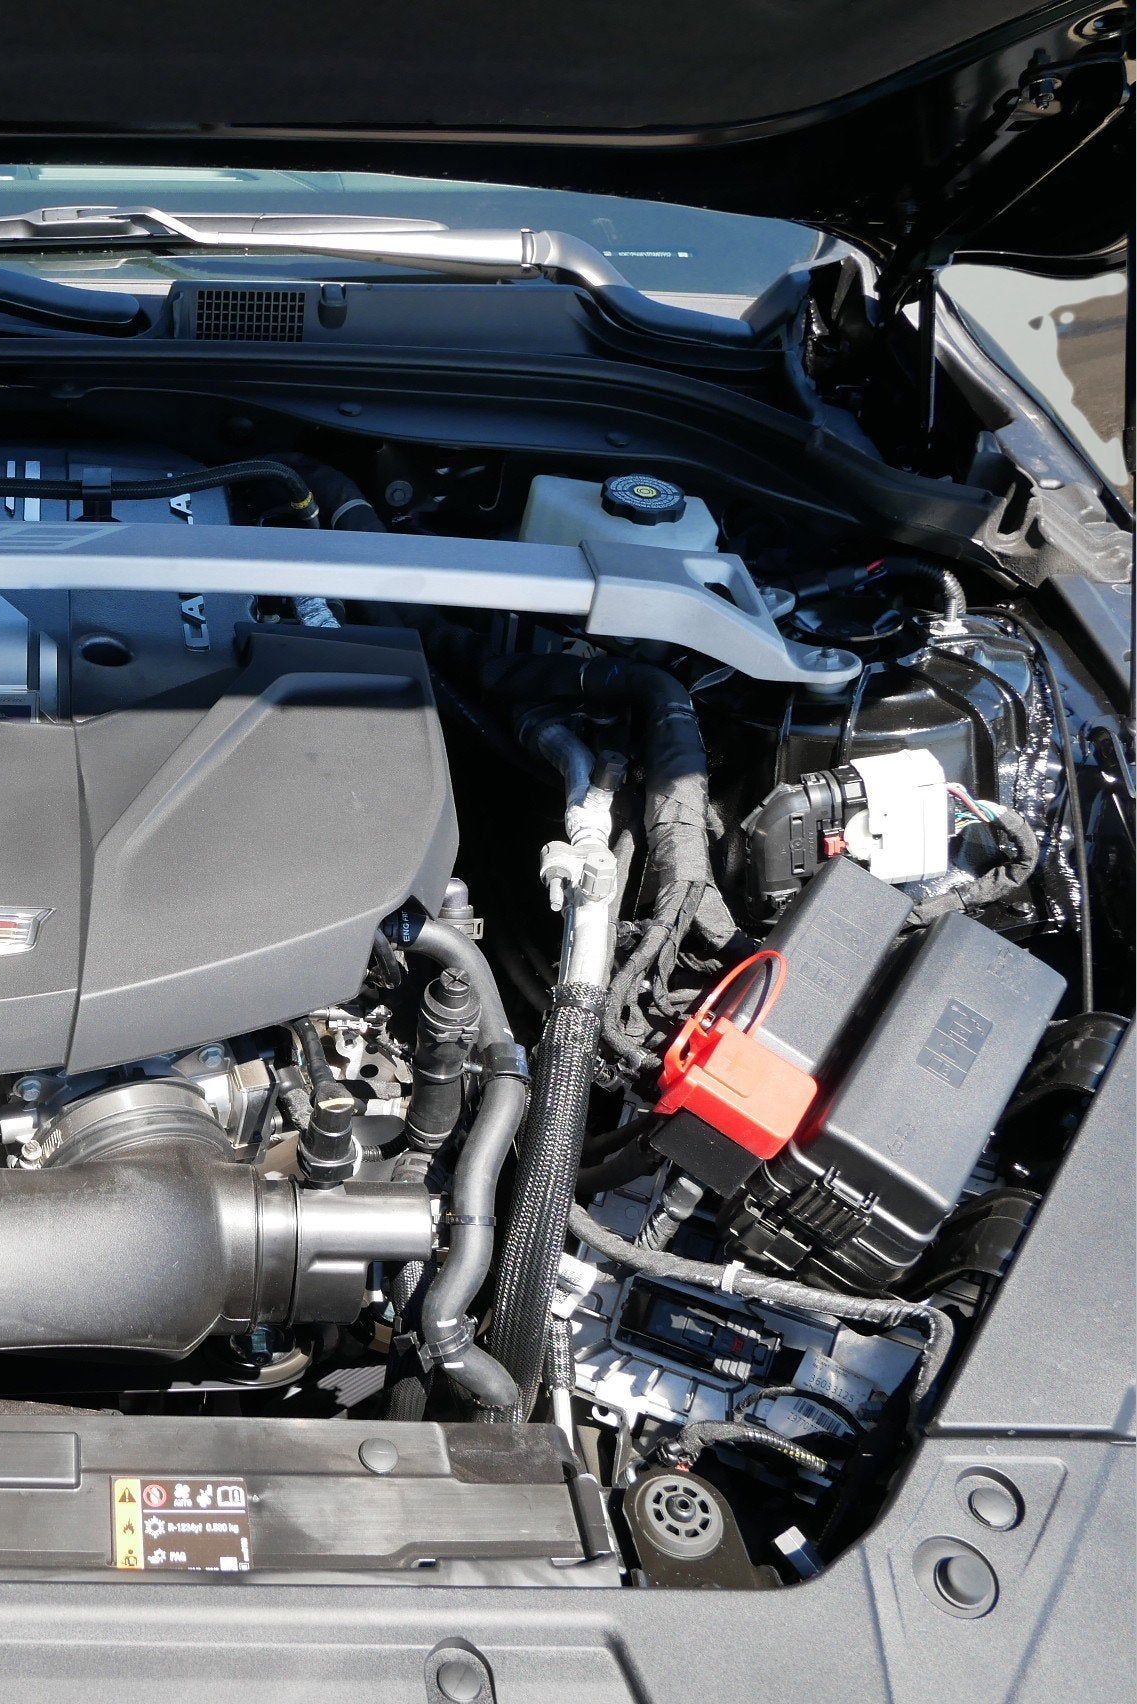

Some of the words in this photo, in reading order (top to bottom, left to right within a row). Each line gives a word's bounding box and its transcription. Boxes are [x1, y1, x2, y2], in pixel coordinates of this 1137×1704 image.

[808, 1375, 855, 1403] 36033125
[228, 1522, 239, 1534] kg
[170, 1552, 186, 1561] PAG
